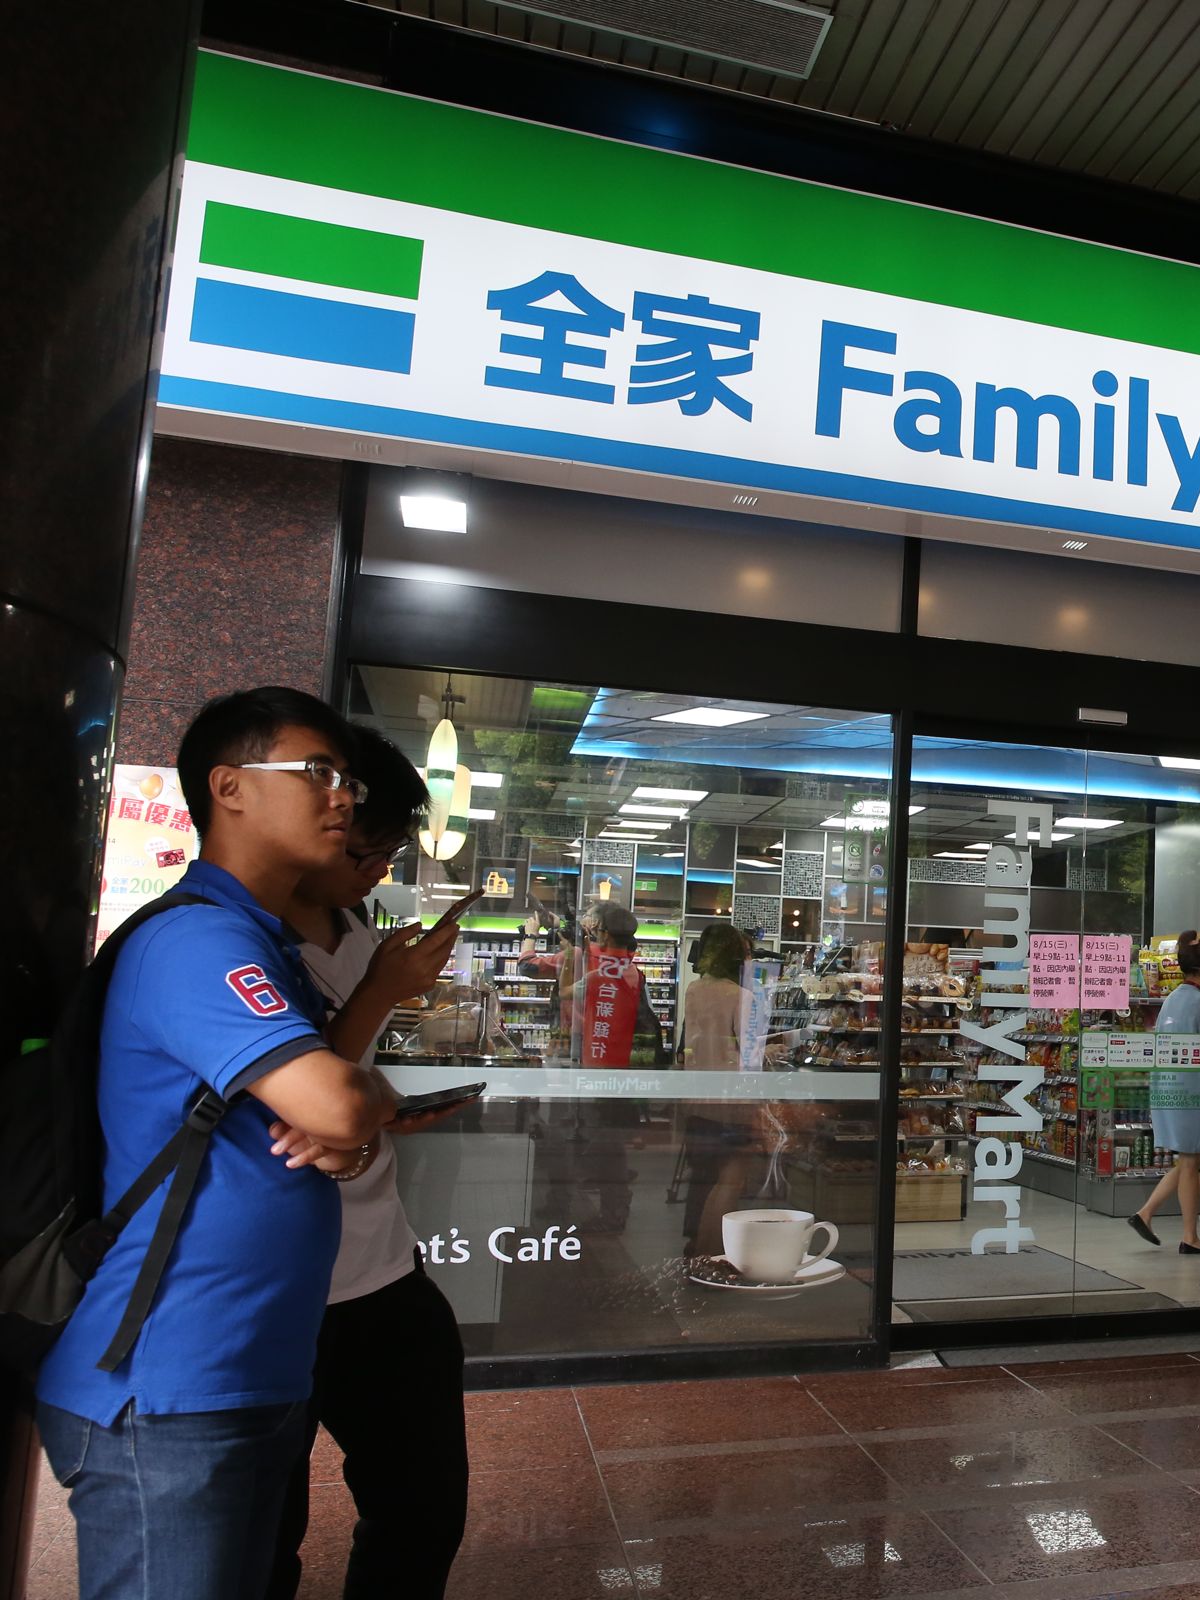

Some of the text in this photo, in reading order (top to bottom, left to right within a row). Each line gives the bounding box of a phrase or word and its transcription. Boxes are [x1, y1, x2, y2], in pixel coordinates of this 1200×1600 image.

[484, 270, 761, 423] 全家
[129, 877, 165, 895] 200
[1033, 953, 1075, 961] 早上9點-11
[1085, 953, 1126, 962] 早上9點-11
[225, 964, 289, 1017] 6
[960, 800, 1053, 1256] FamilyMart
[576, 1076, 661, 1095] FamilyMart
[417, 1224, 582, 1264] et's Café
